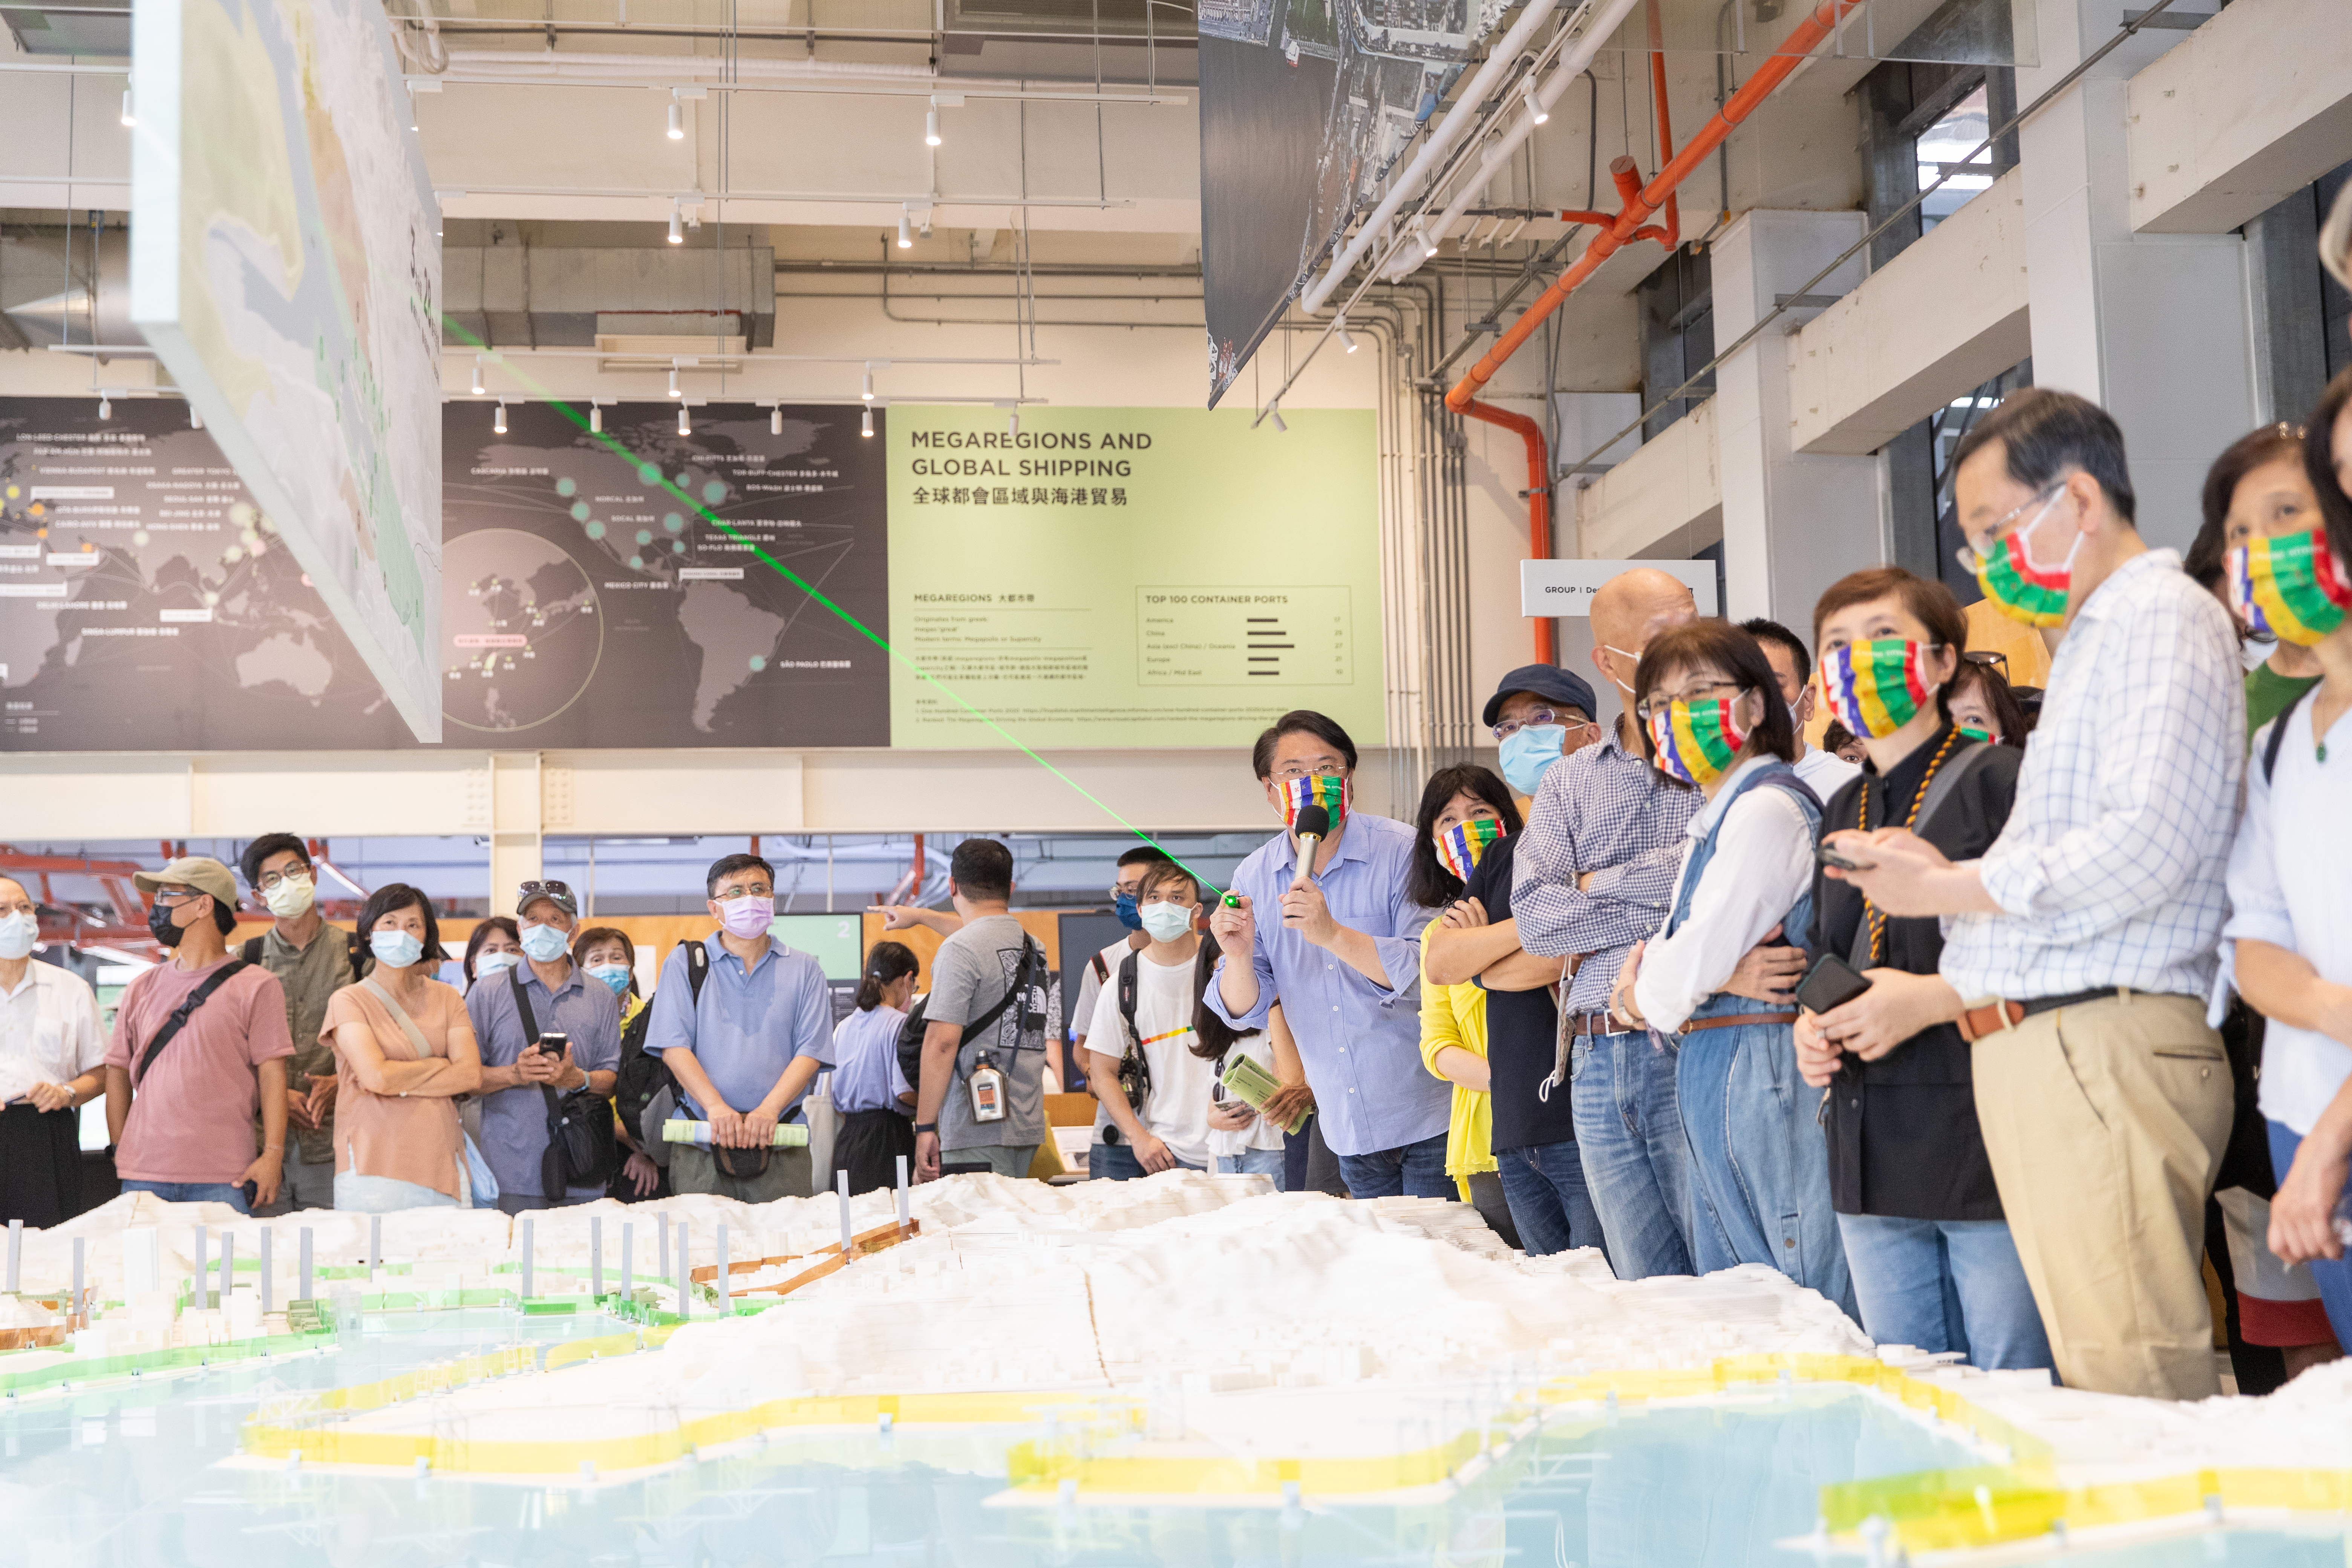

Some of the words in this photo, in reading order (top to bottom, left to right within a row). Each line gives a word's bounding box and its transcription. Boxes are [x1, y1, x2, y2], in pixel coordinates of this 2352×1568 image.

[912, 432, 1092, 449] MEGAREGIONS
[1101, 433, 1152, 449] AND
[912, 459, 1010, 476] GLOBAL
[1020, 460, 1132, 477] SHIPPING
[913, 487, 1127, 506] 全球都會區域與海港貿易
[914, 594, 992, 603] MEGAREGIONS
[837, 921, 850, 938] 2
